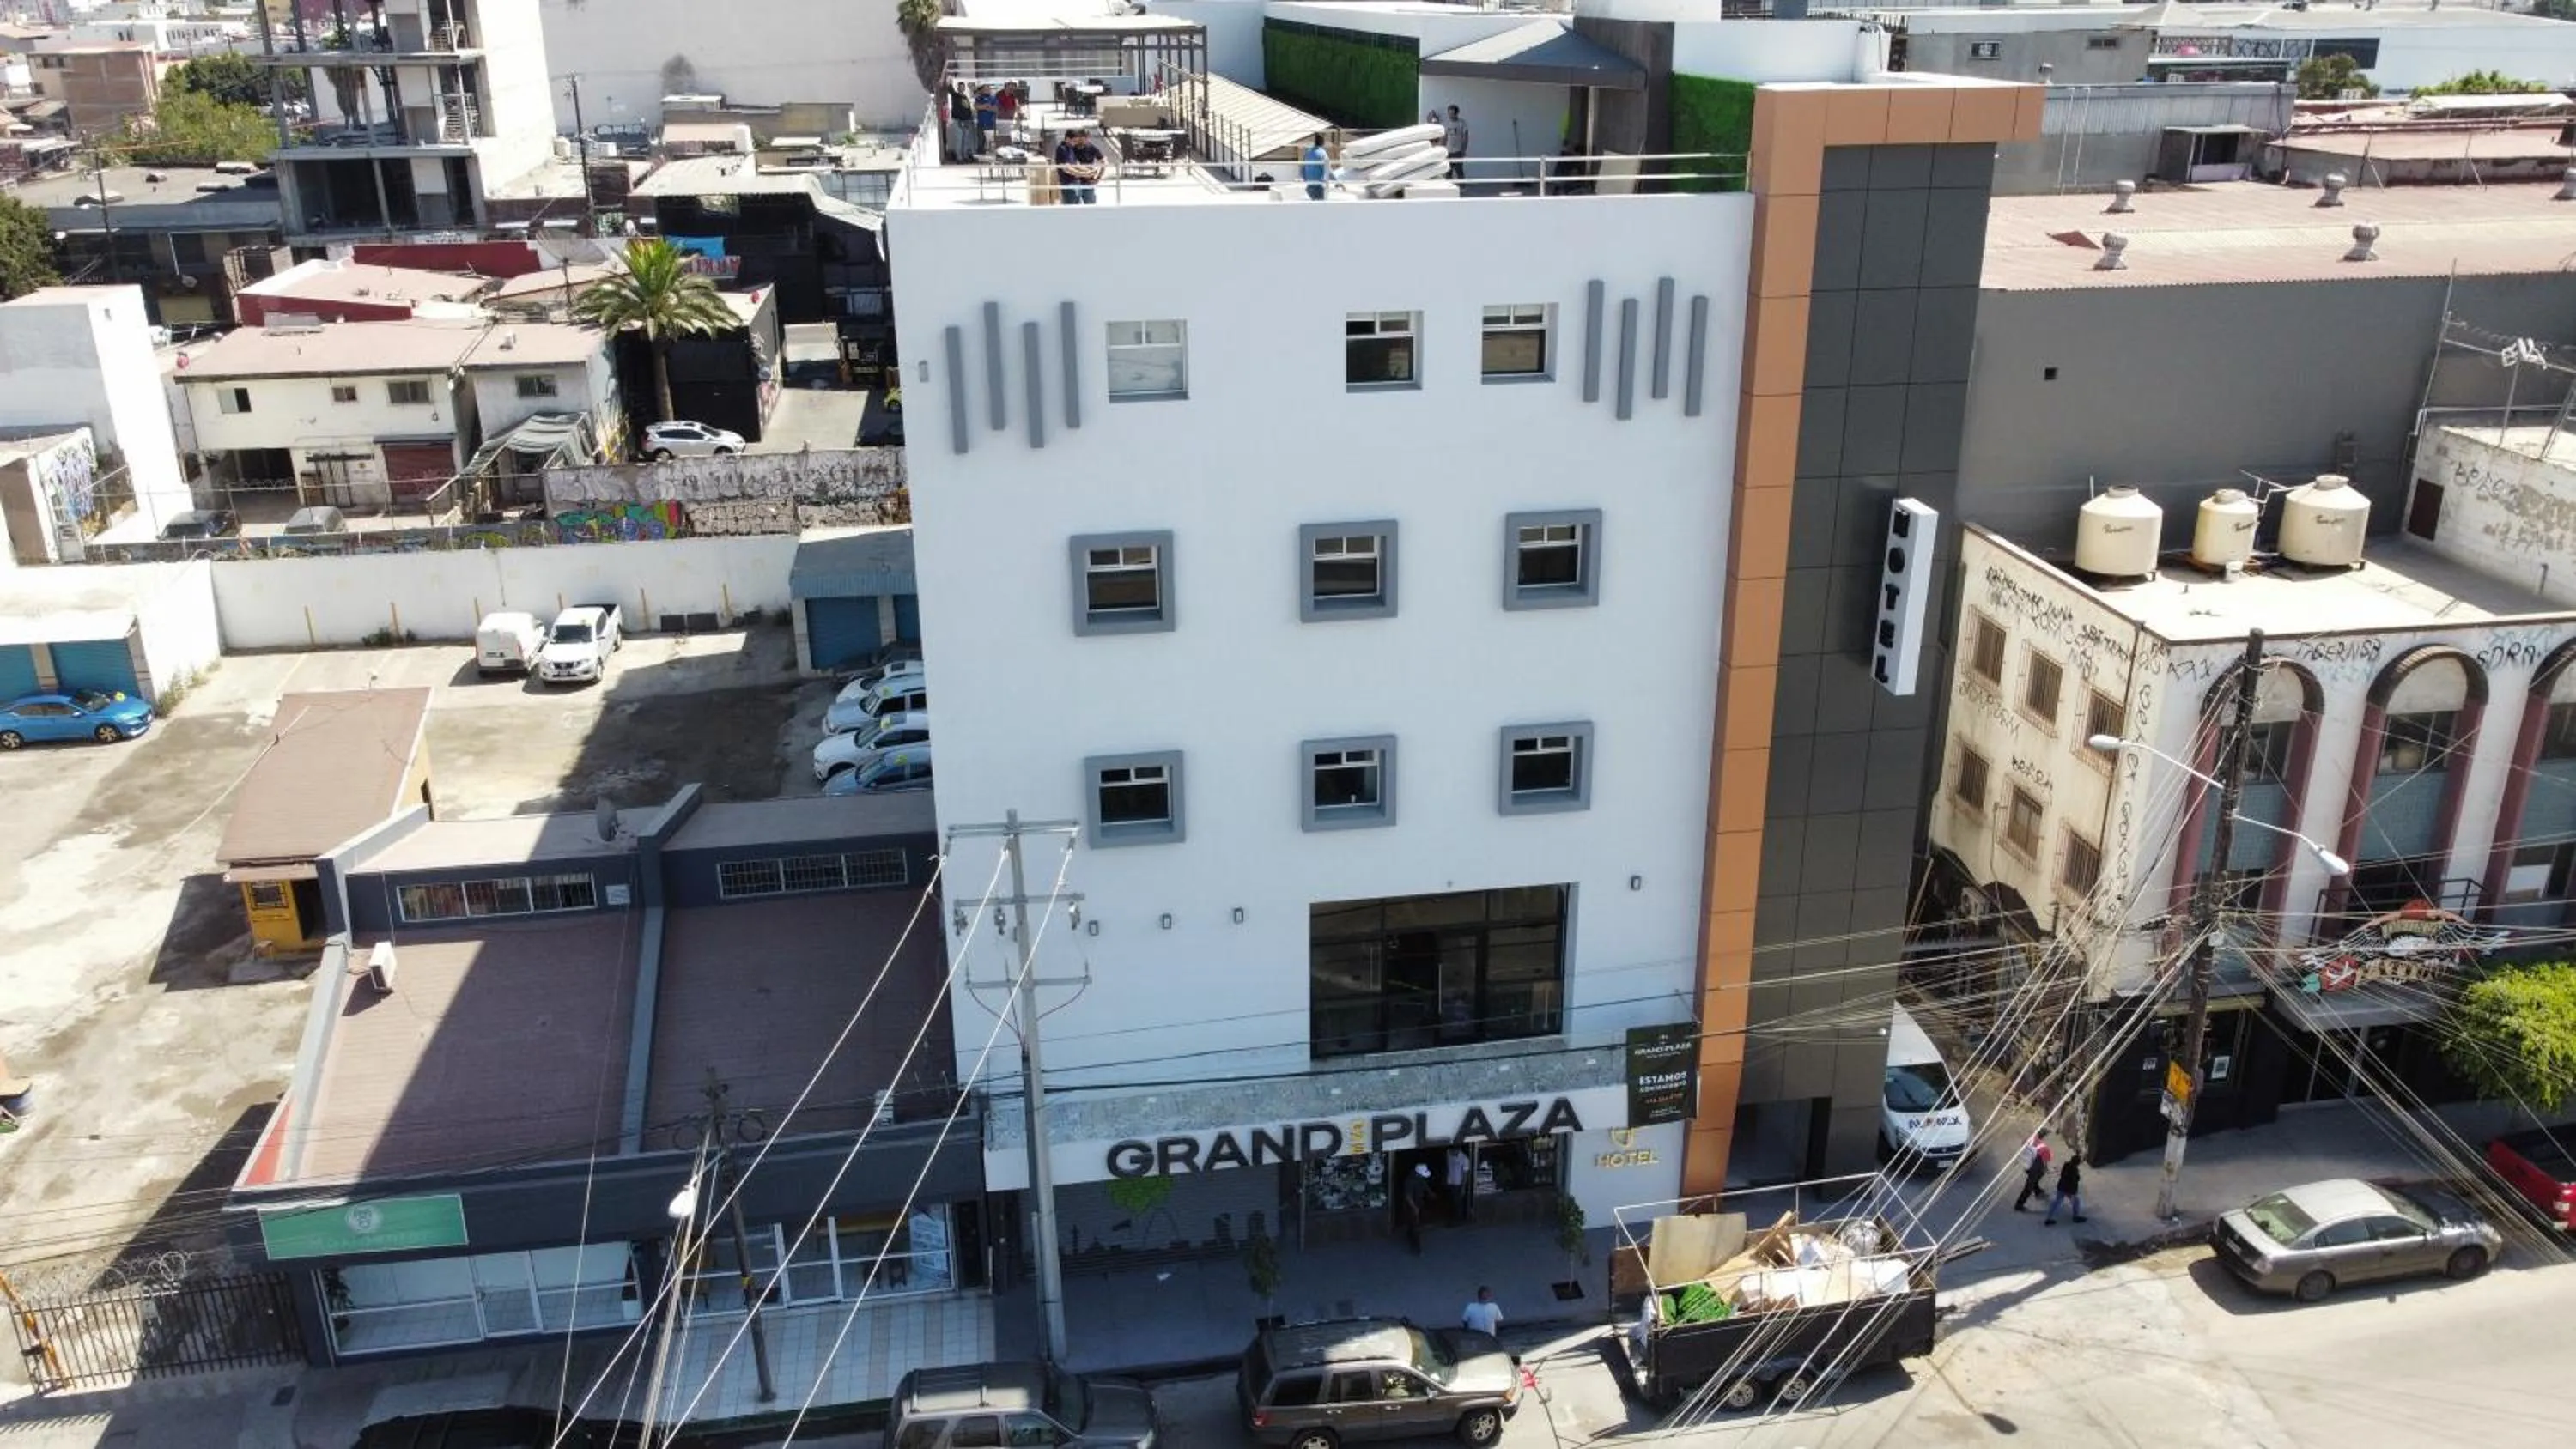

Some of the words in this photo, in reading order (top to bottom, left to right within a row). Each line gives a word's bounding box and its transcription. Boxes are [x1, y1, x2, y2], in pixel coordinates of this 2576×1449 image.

[1874, 508, 1911, 684] HOTEL
[1639, 1071, 1687, 1086] ESTAMOS
[1107, 1121, 1343, 1179] GRAND
[1371, 1096, 1583, 1153] PLAZA
[1595, 1149, 1661, 1167] HOTEL
